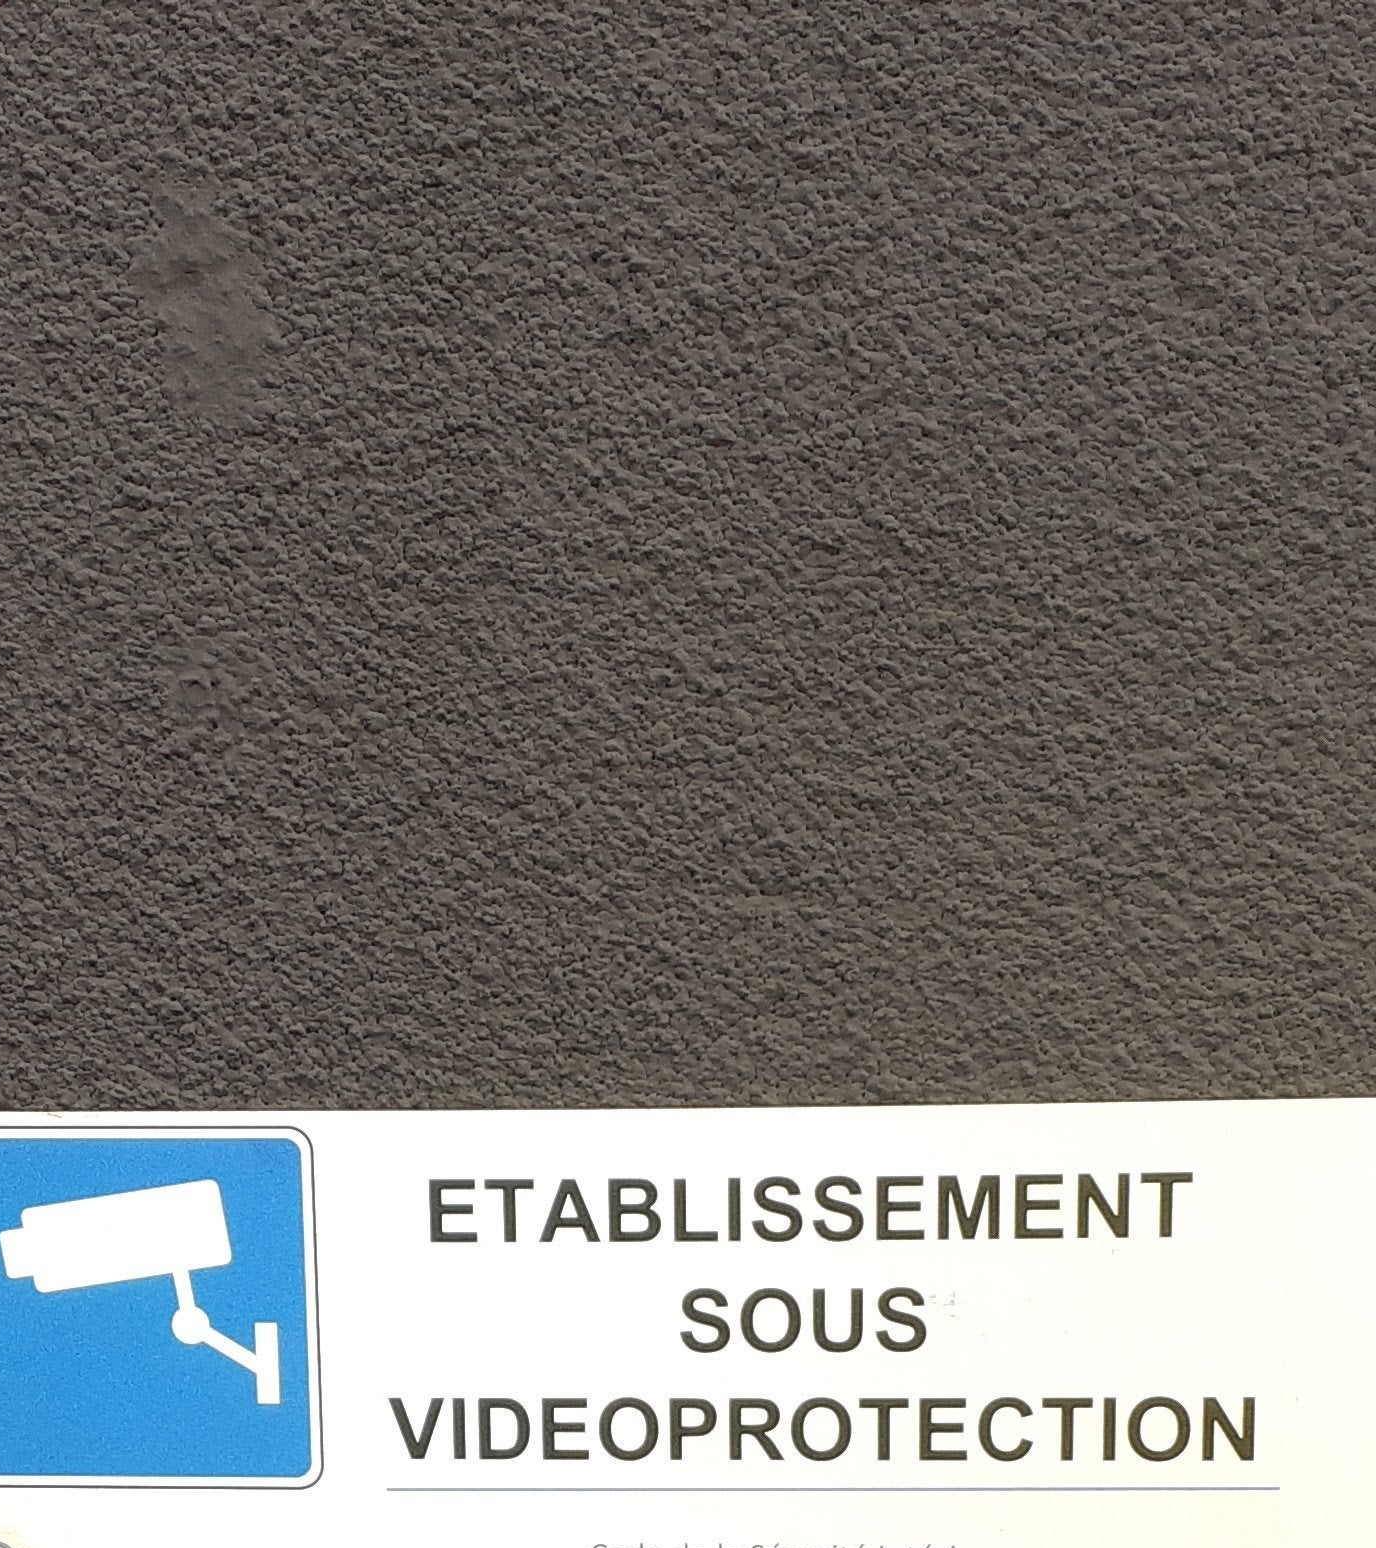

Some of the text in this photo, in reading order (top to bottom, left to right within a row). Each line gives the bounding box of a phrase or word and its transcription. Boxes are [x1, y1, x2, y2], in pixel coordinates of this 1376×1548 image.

[428, 1171, 1194, 1244] ETABLISSEMENT
[679, 1286, 928, 1354] SOUS
[387, 1395, 1257, 1463] VIDEOPROTECTION
